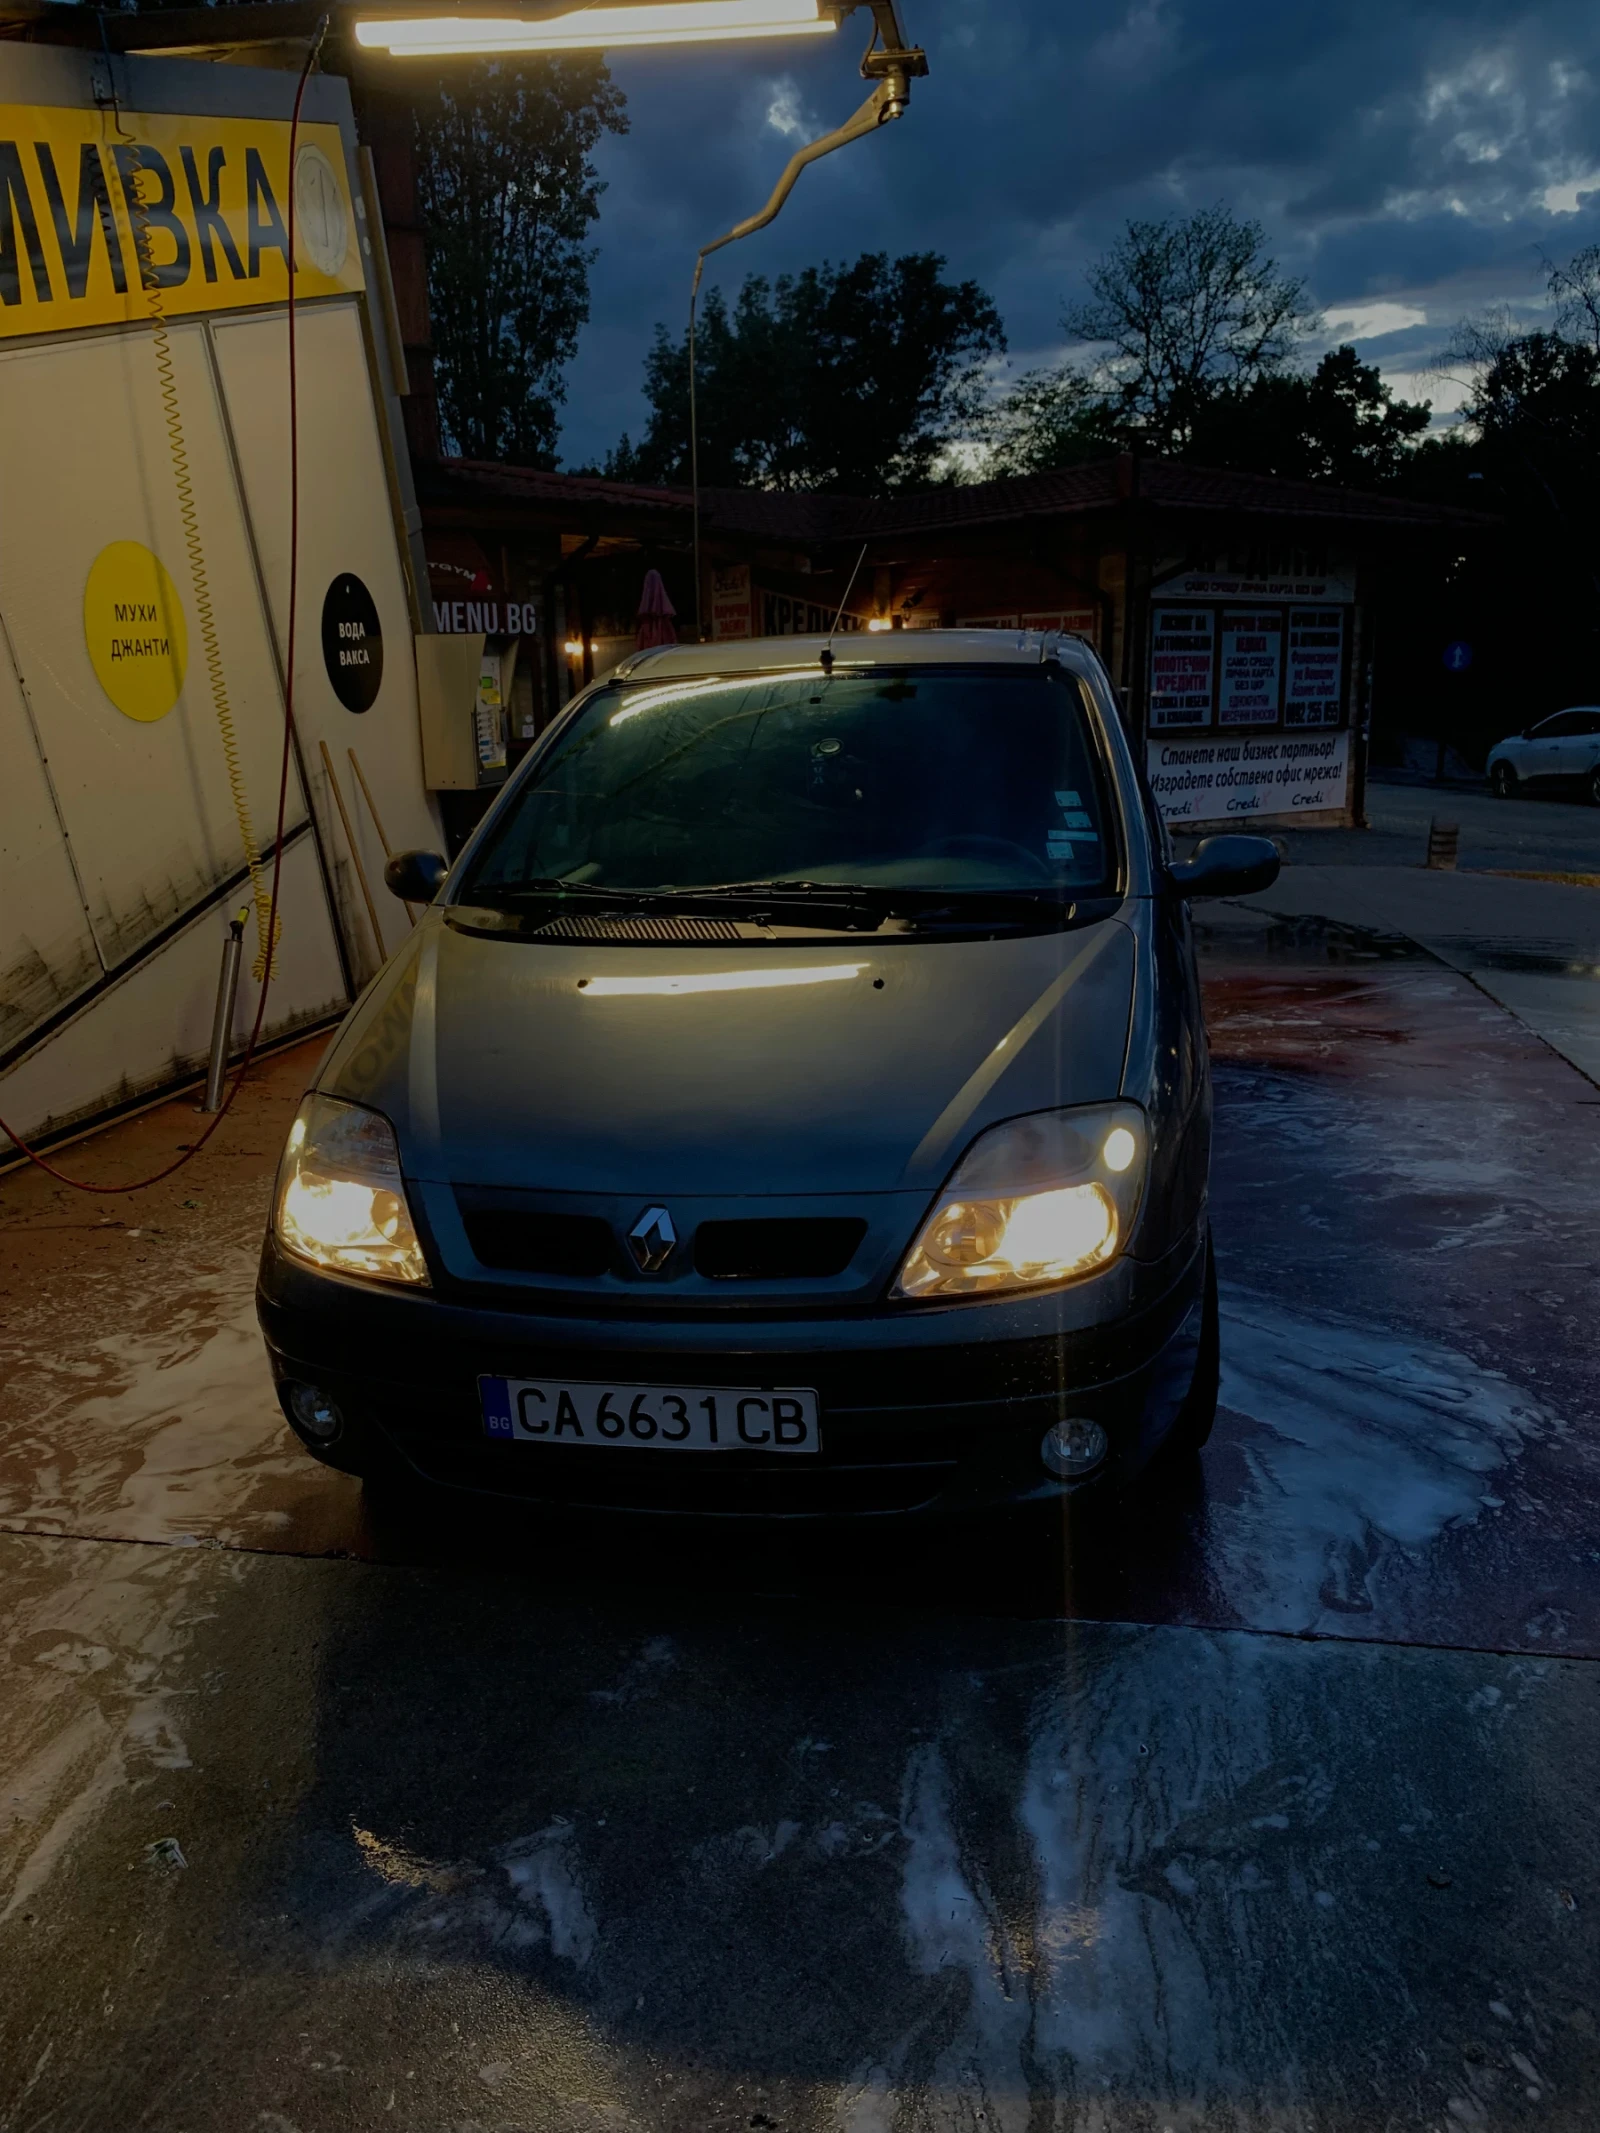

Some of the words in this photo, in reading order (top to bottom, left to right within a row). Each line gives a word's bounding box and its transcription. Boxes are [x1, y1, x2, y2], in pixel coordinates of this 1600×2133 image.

[114, 603, 158, 622] МУХИ
[338, 621, 366, 641] ВОДА
[111, 637, 170, 662] ДЖАНТИ
[339, 648, 371, 667] ВАКСА
[1161, 747, 1215, 766] Станете
[1217, 747, 1239, 763] наш
[1243, 740, 1278, 761] бизнес
[1280, 738, 1336, 758] партньор!
[1151, 770, 1213, 795] Изградете
[1215, 766, 1273, 787] собствена
[1276, 763, 1301, 786] офис
[1303, 762, 1343, 786] мрежа!
[488, 1415, 511, 1430] BG
[596, 1392, 718, 1443] 6631
